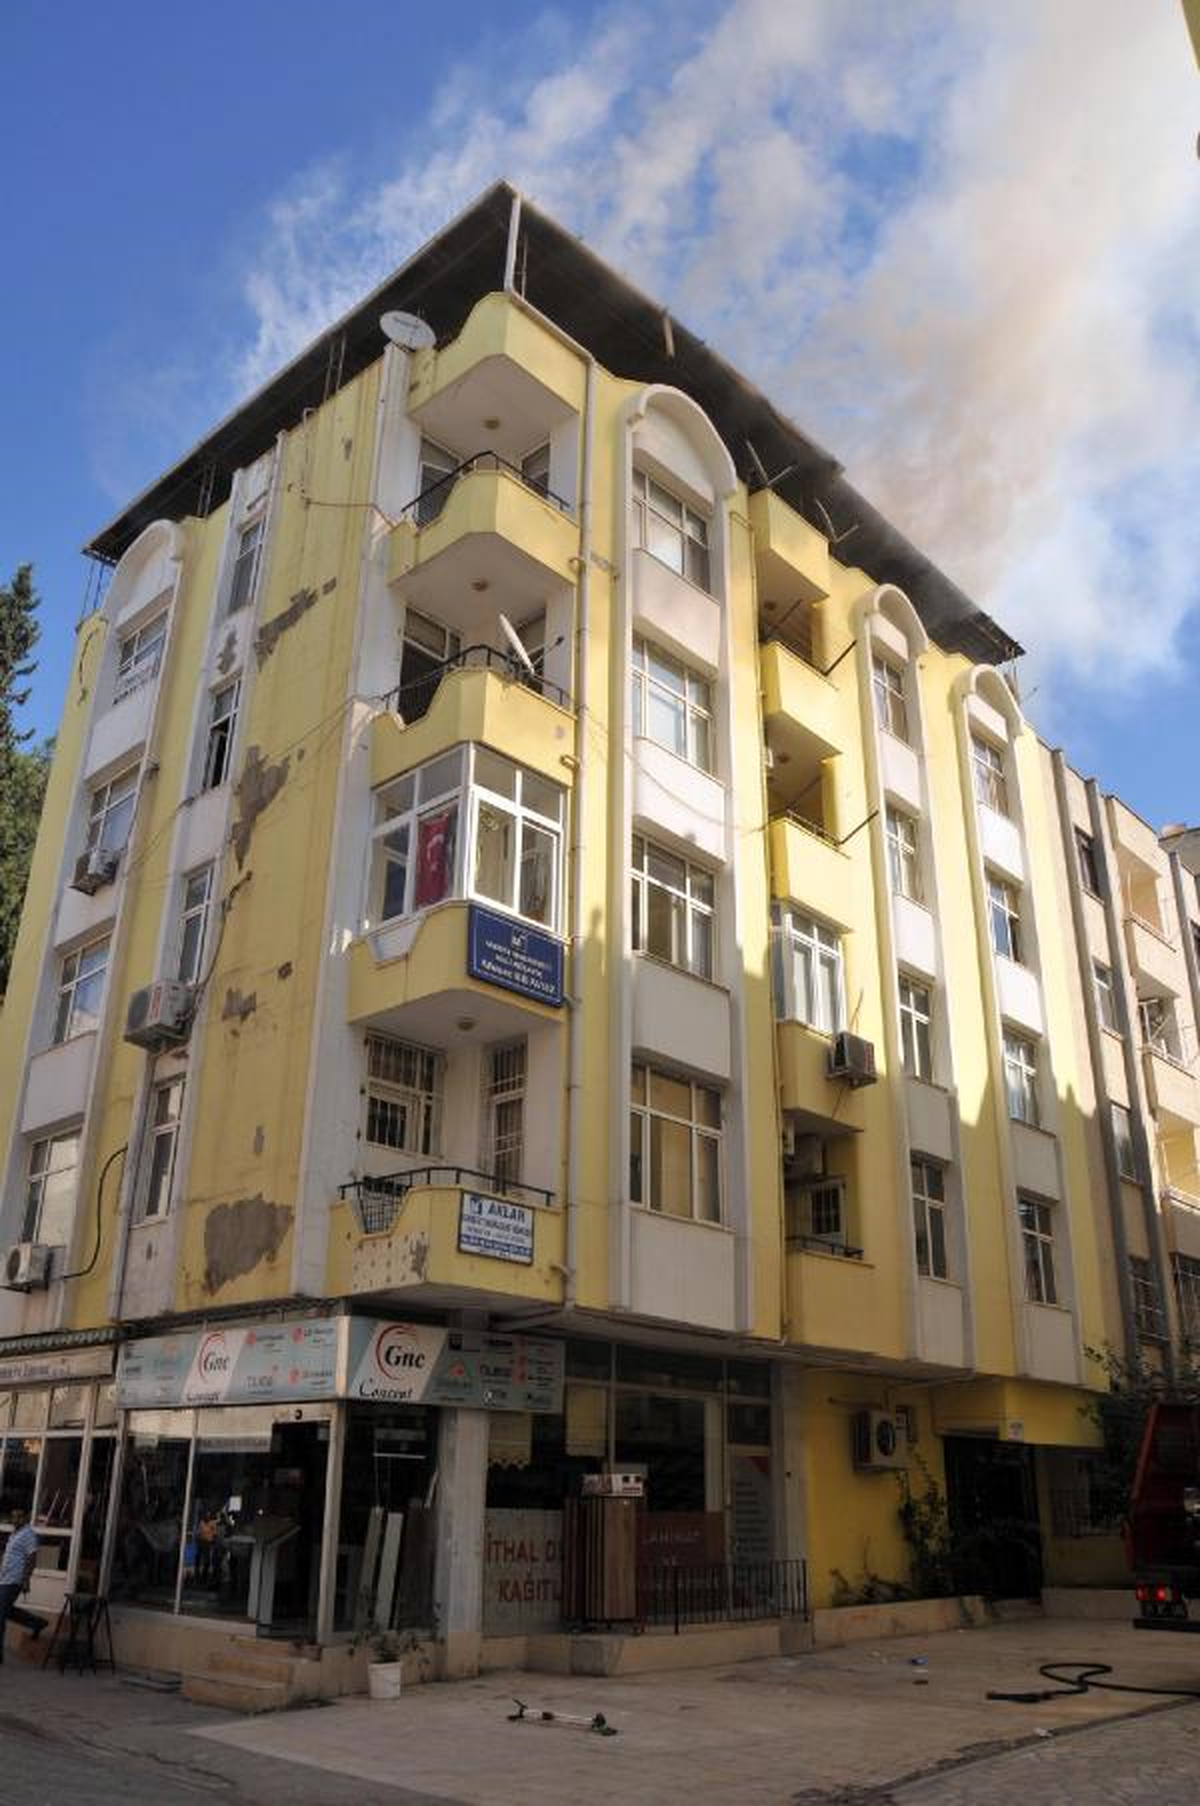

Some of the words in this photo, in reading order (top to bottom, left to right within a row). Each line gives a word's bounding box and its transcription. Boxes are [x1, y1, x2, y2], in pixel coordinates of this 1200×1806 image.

[203, 1352, 230, 1372] Gnc
[384, 1345, 425, 1369] Gnc
[487, 1533, 538, 1563] İTHAL
